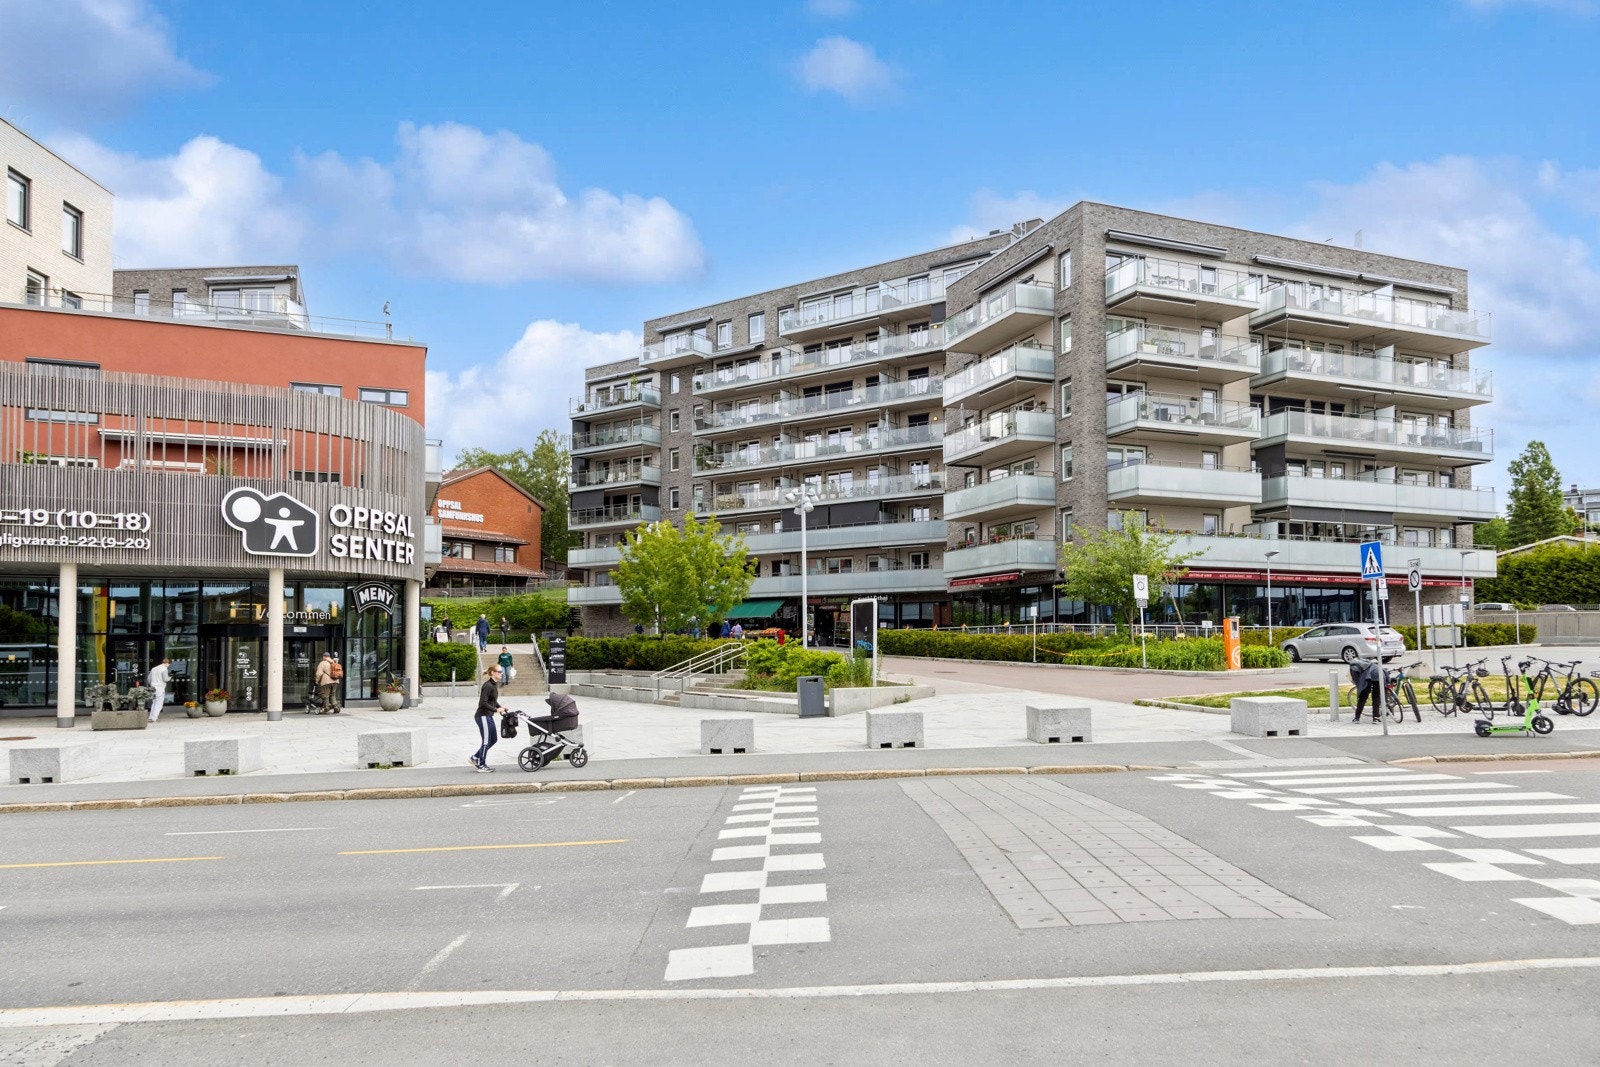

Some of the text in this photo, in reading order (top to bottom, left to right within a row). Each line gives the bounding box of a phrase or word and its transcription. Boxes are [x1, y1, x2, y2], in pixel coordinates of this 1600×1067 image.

[438, 499, 462, 510] OPPSAL
[0, 508, 49, 527] –19
[329, 504, 415, 538] OPPSAL
[330, 534, 415, 565] SENTER
[359, 587, 394, 605] MENY
